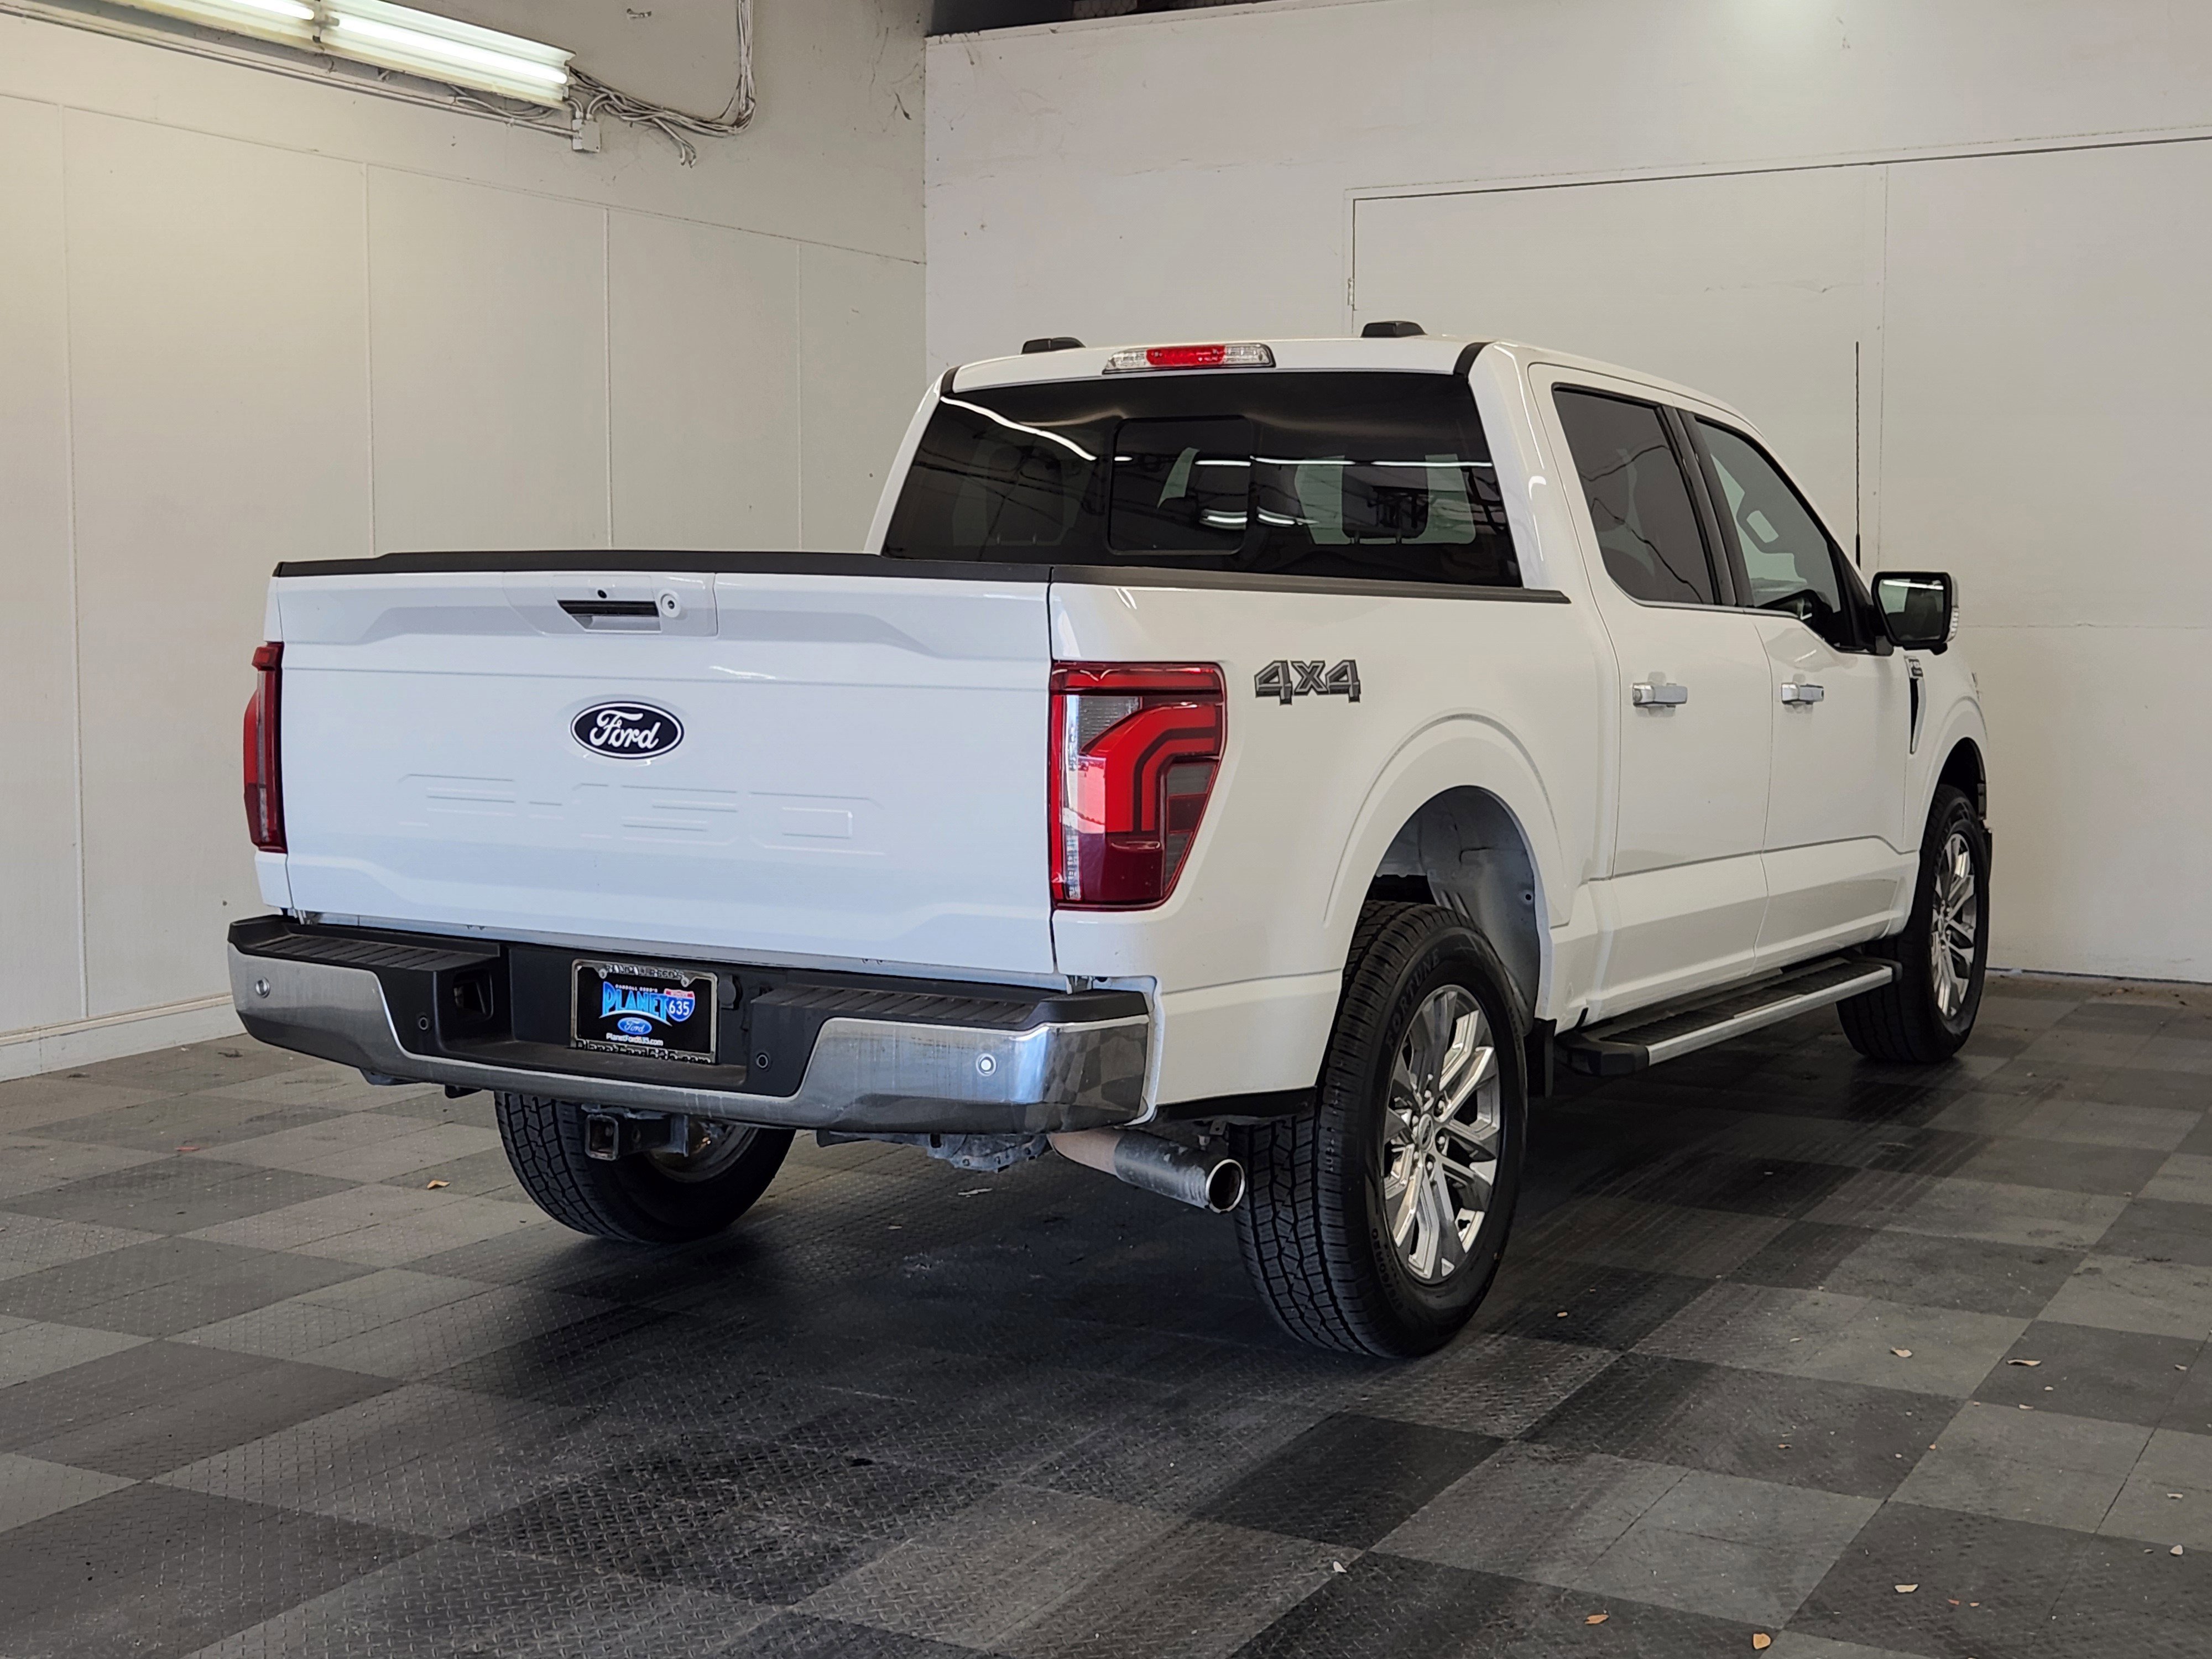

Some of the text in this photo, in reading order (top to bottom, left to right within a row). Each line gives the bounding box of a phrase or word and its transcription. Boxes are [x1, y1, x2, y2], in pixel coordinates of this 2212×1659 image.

[589, 709, 661, 749] Ford
[603, 981, 669, 1020] PLANET
[669, 999, 690, 1016] 635
[1385, 947, 1441, 1052] FORTUNE
